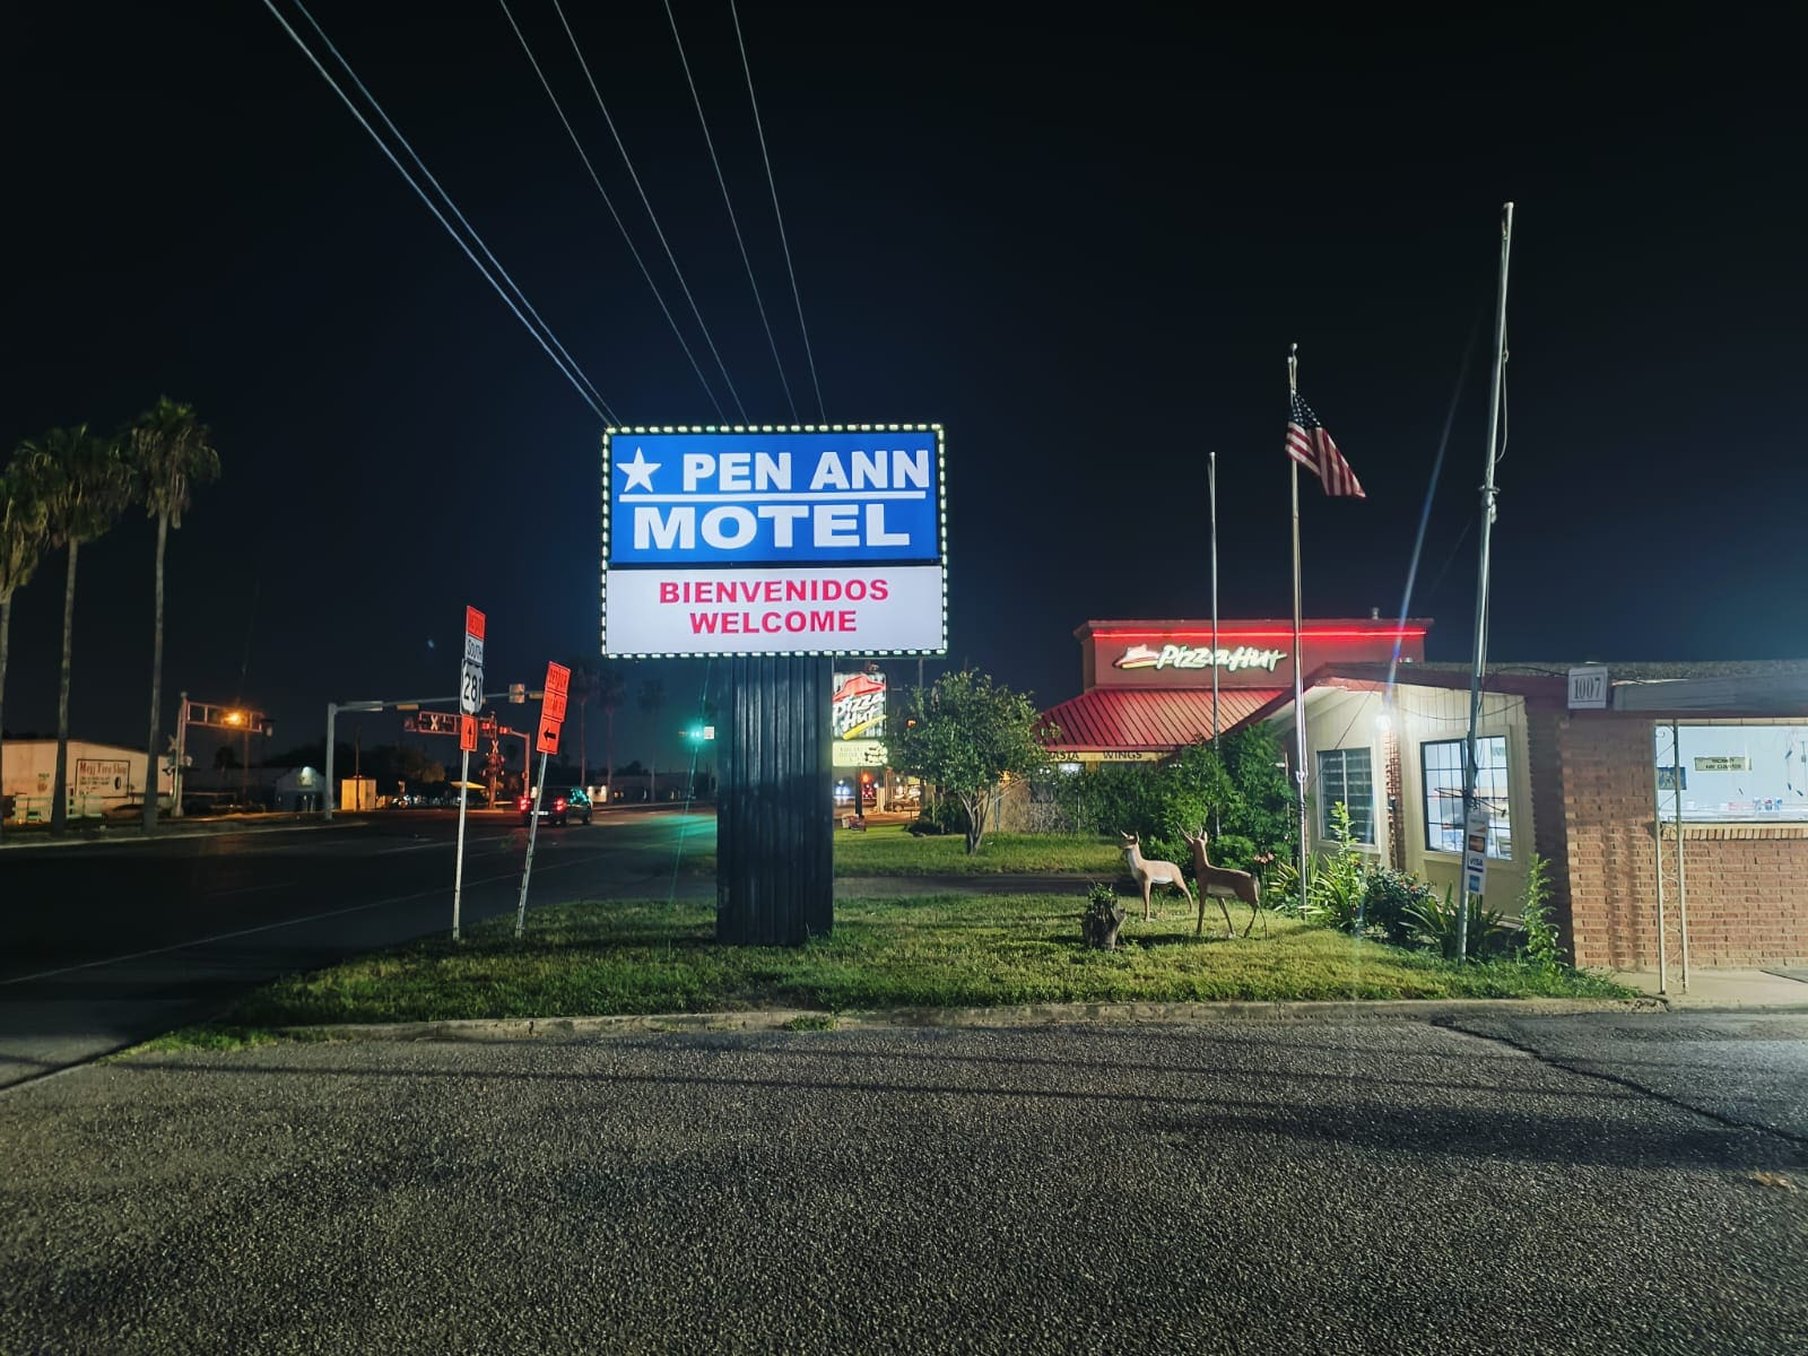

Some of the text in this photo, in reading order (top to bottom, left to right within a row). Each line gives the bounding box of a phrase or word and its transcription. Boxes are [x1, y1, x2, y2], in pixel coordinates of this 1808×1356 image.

[683, 450, 930, 491] PEN ANN
[634, 504, 910, 550] MOTEL
[659, 579, 889, 604] BIENVENIDOS
[690, 610, 857, 634] WELCOME
[1157, 644, 1288, 671] Pizza Hut
[463, 672, 482, 705] 281
[1574, 676, 1601, 699] 1007
